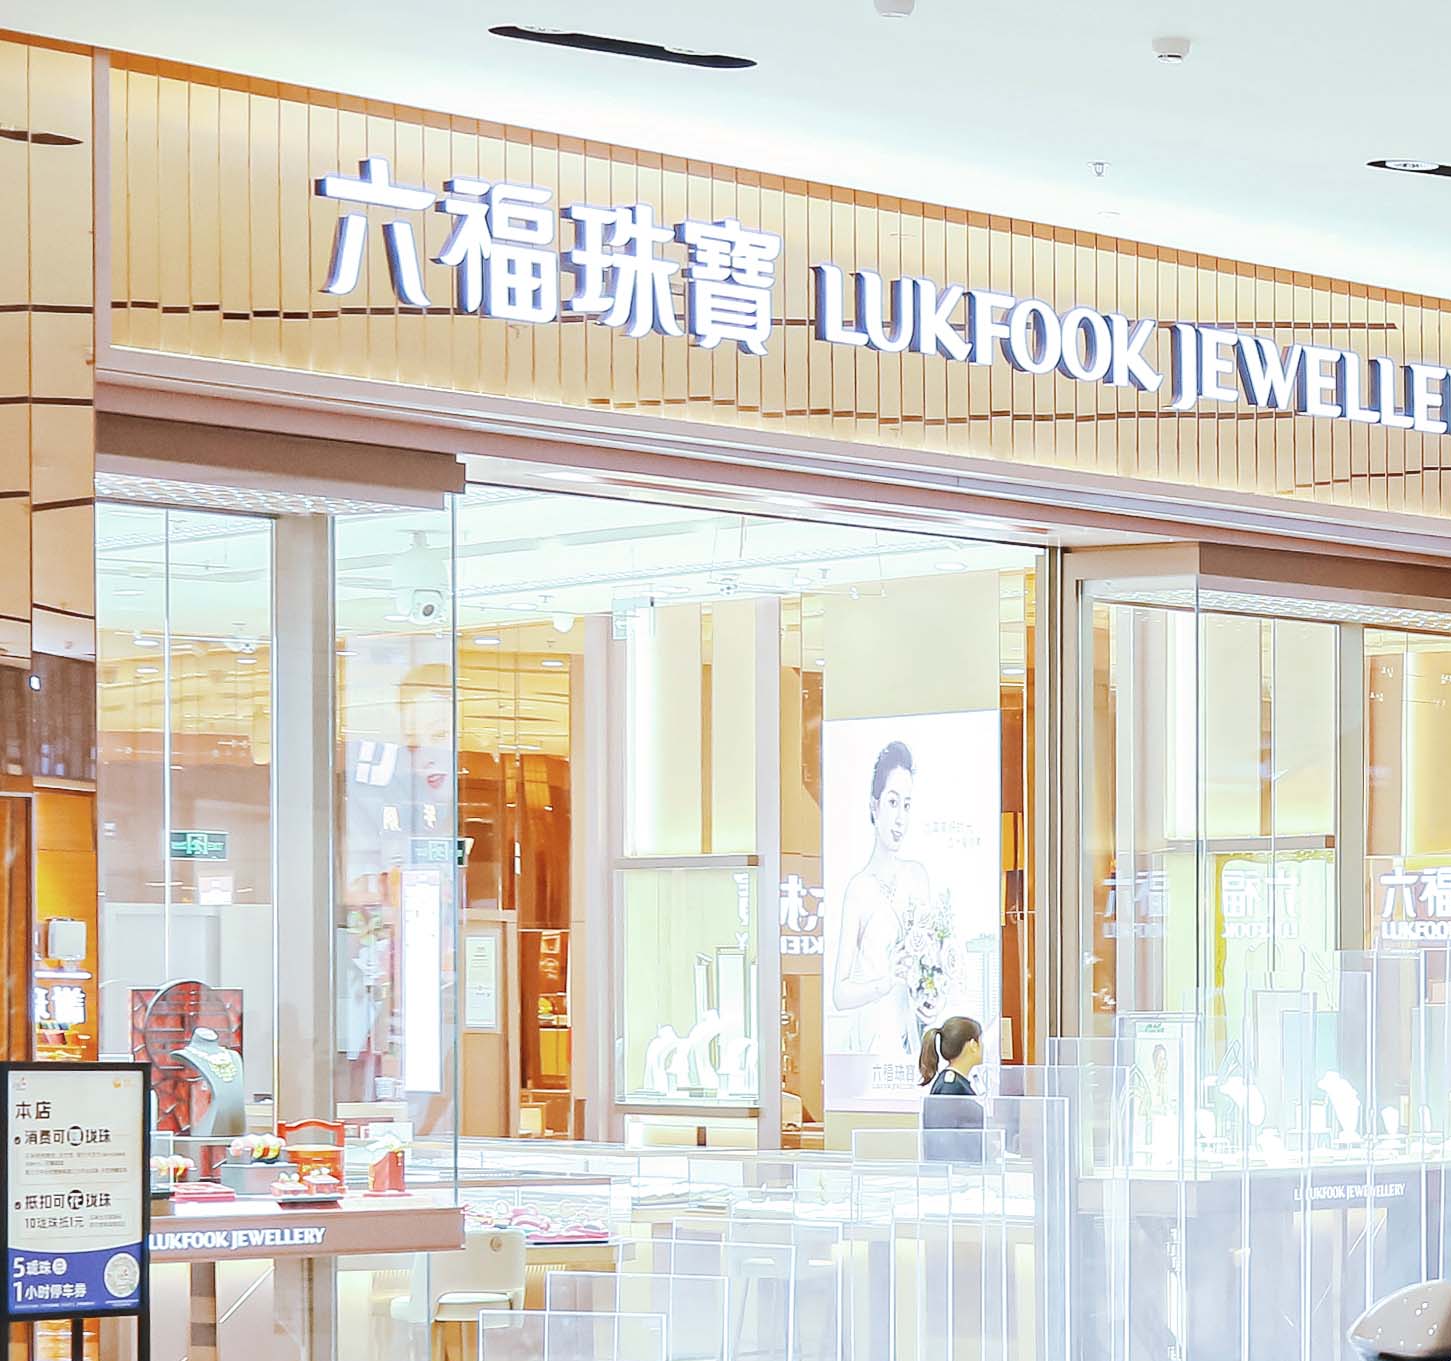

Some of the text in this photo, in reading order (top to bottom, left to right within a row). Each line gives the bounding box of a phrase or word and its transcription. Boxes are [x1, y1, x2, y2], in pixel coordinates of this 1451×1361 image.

[314, 155, 782, 356] 六福珠寶
[812, 262, 1164, 394] LUKFOOK
[15, 1101, 52, 1120] 本店
[149, 1227, 326, 1251] LUKFOOK JEWELLERY
